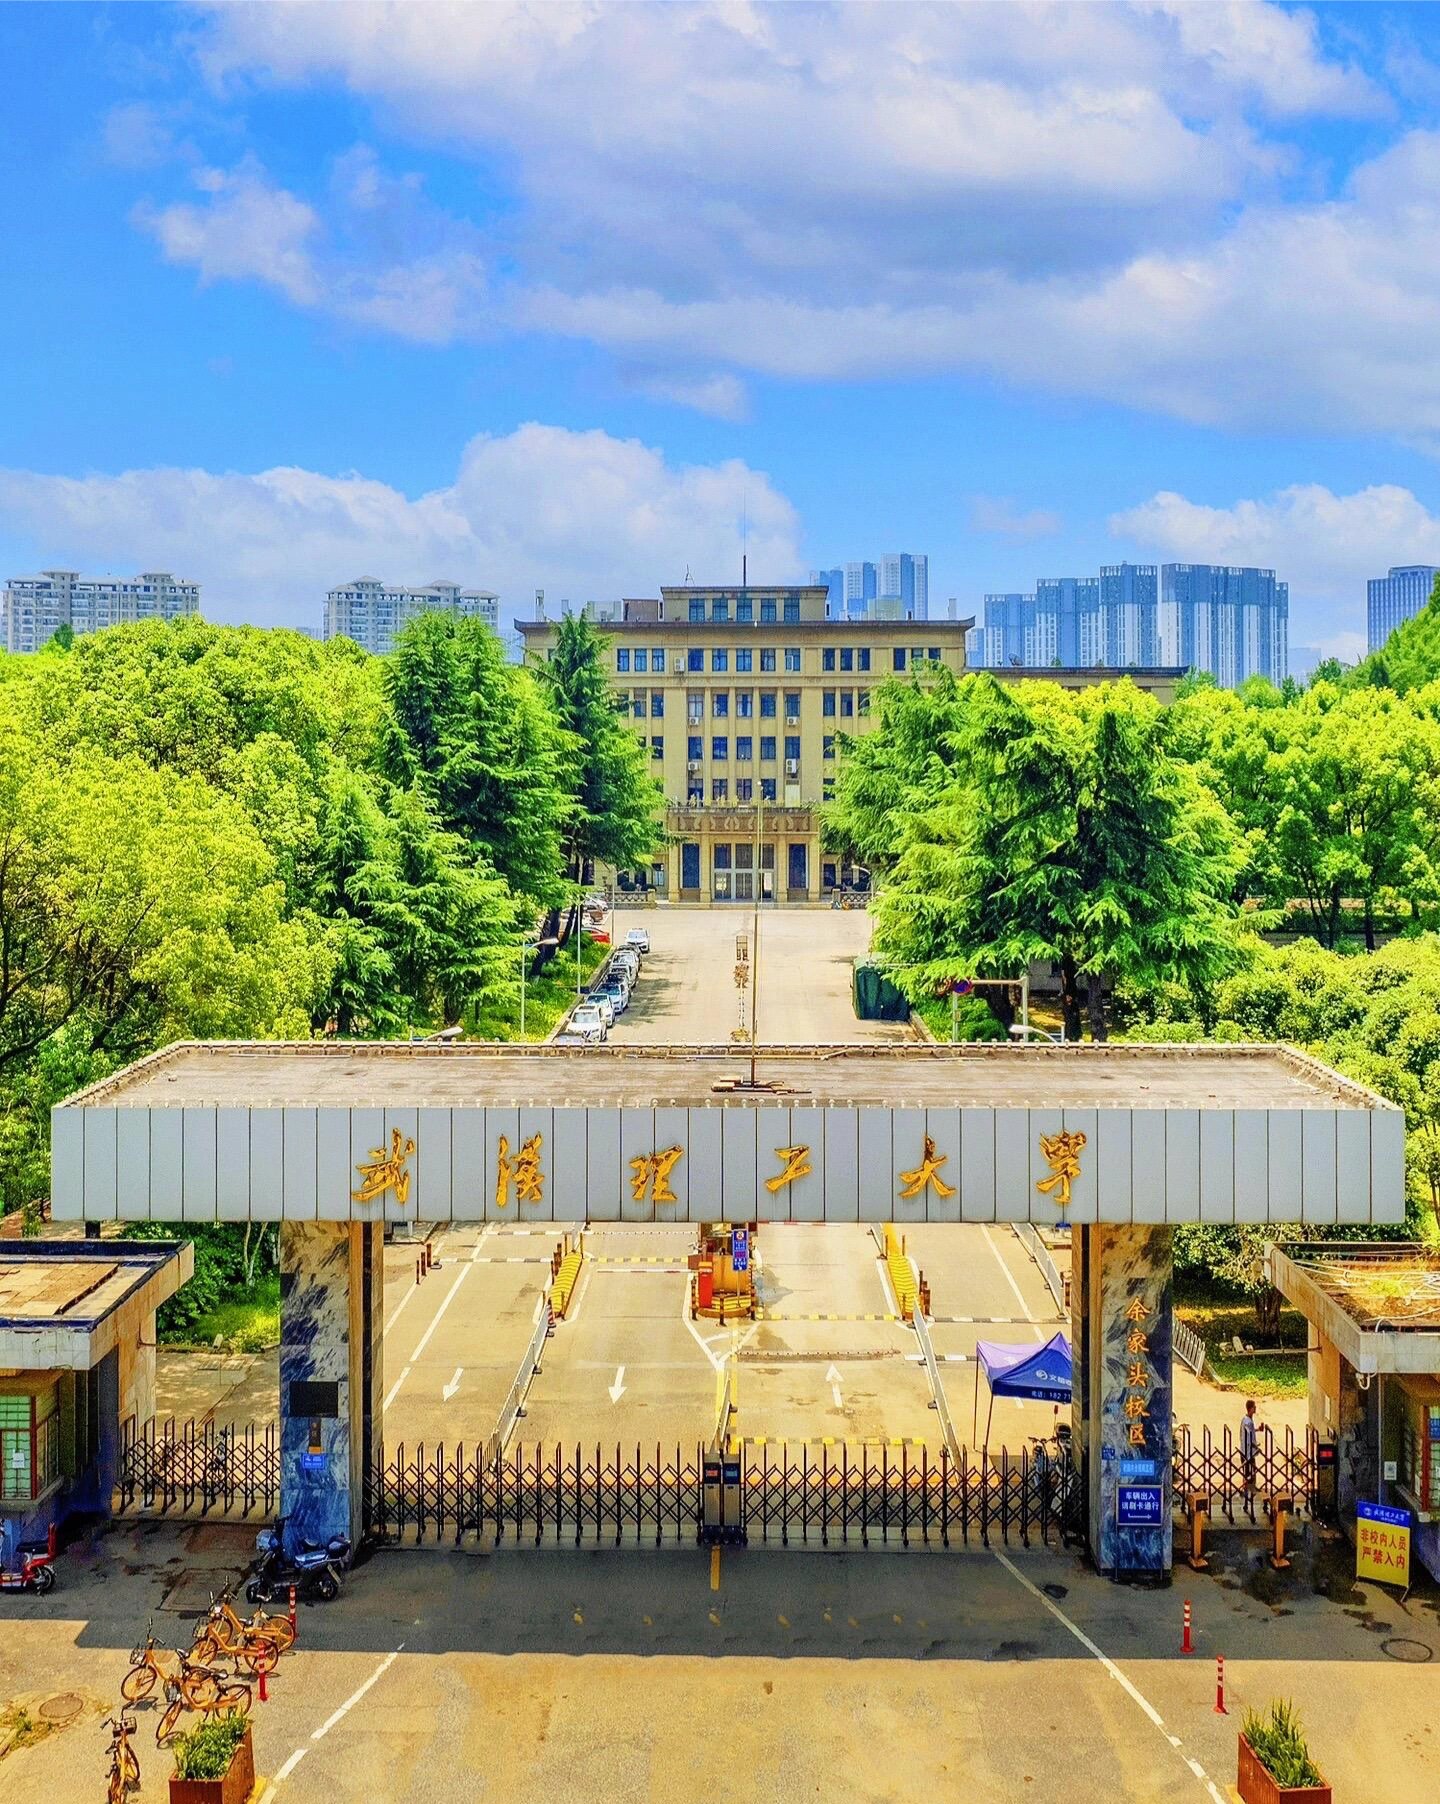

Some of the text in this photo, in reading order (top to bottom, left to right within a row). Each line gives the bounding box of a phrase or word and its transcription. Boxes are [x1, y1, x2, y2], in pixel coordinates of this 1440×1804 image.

[1125, 1297, 1151, 1446] 余家头校区
[1125, 1491, 1156, 1500] 车辆出入
[1360, 1527, 1407, 1551] 非校内人员
[1362, 1545, 1406, 1570] 严禁入内
